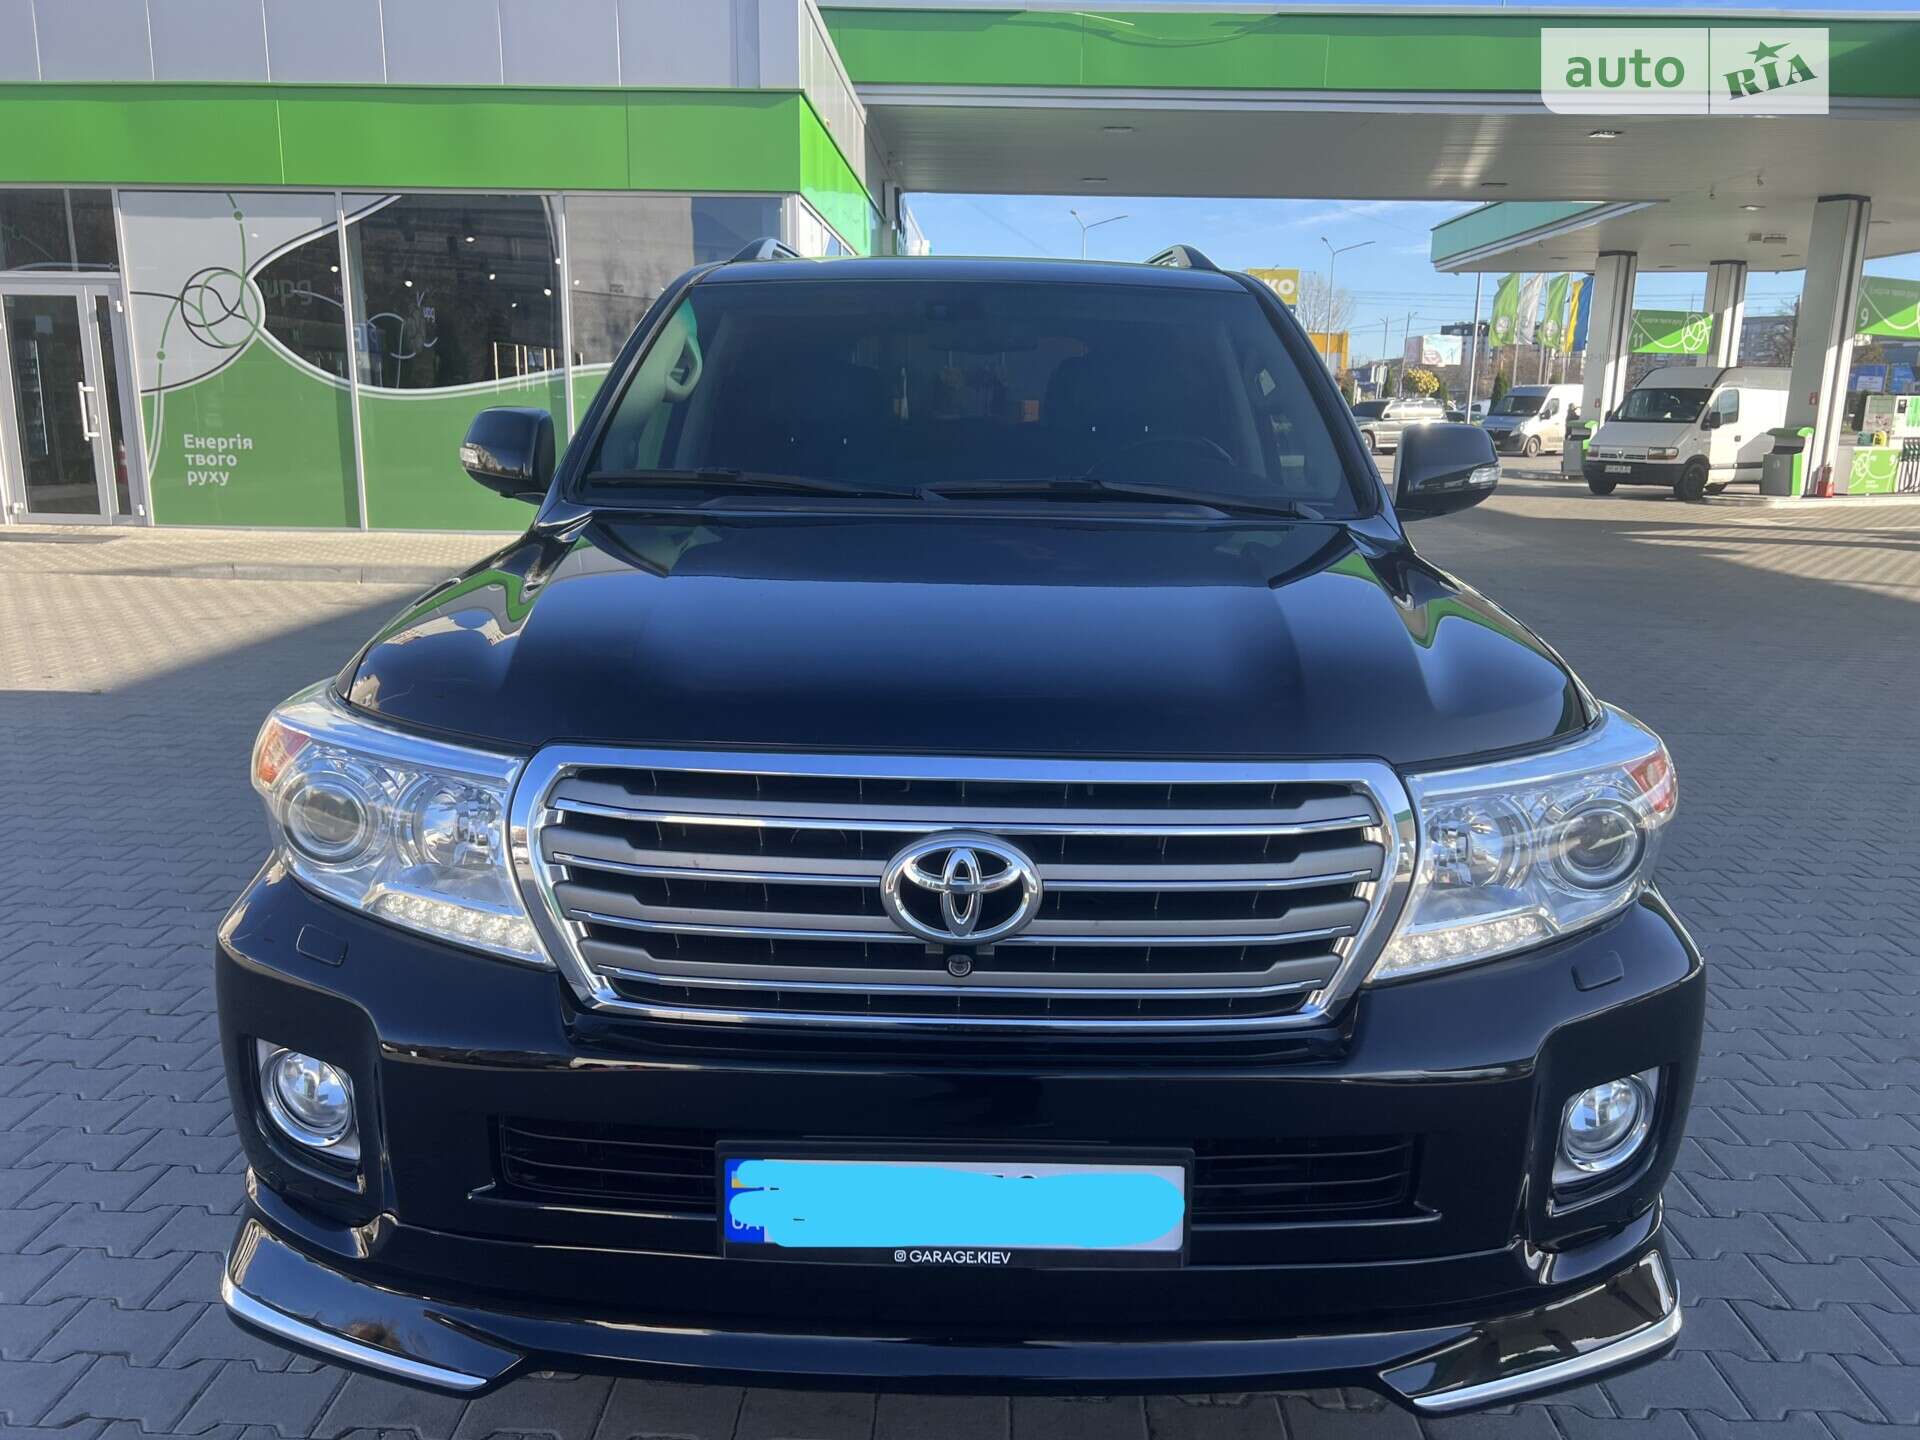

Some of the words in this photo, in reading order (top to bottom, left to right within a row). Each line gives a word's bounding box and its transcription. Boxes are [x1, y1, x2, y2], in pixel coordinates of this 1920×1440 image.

[183, 433, 253, 453] Енергія
[184, 454, 238, 467] твого
[187, 470, 230, 487] руху
